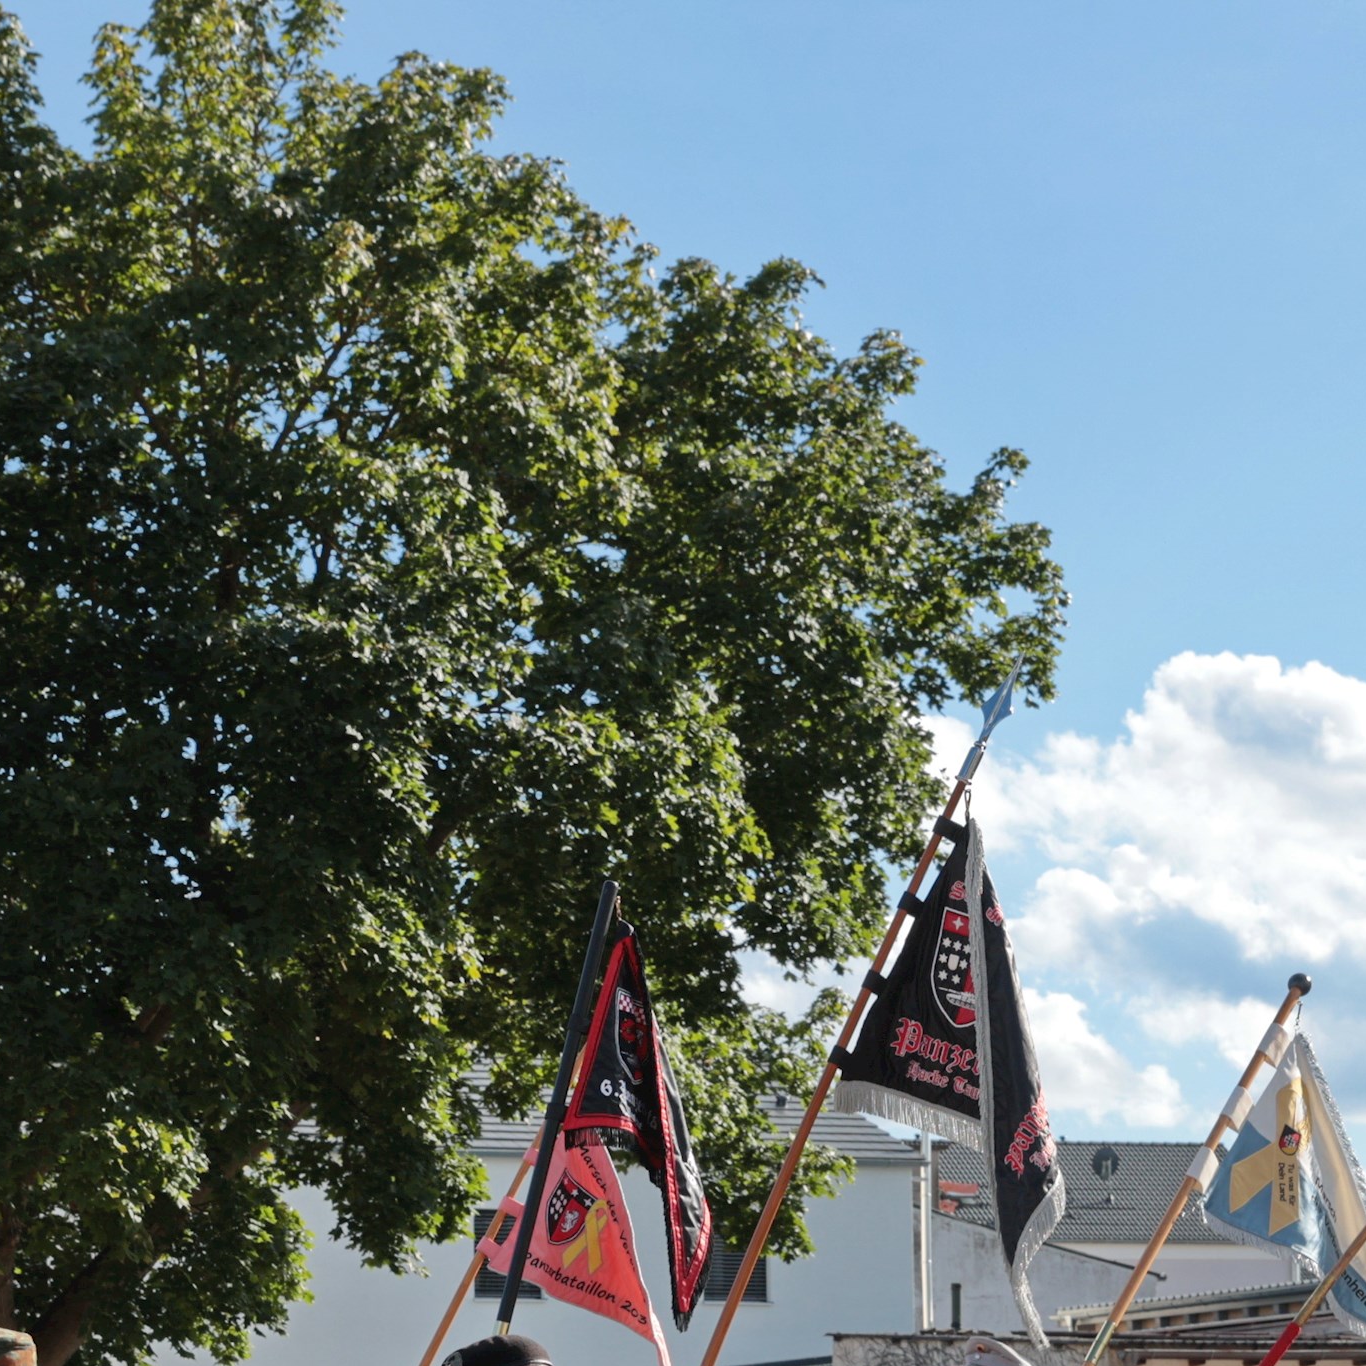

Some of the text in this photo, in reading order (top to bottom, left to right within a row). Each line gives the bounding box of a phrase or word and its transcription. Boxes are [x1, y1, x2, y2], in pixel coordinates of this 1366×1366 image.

[1278, 1162, 1287, 1203] Dein Land
[606, 1200, 620, 1224] der
[620, 1300, 648, 1326] 203
